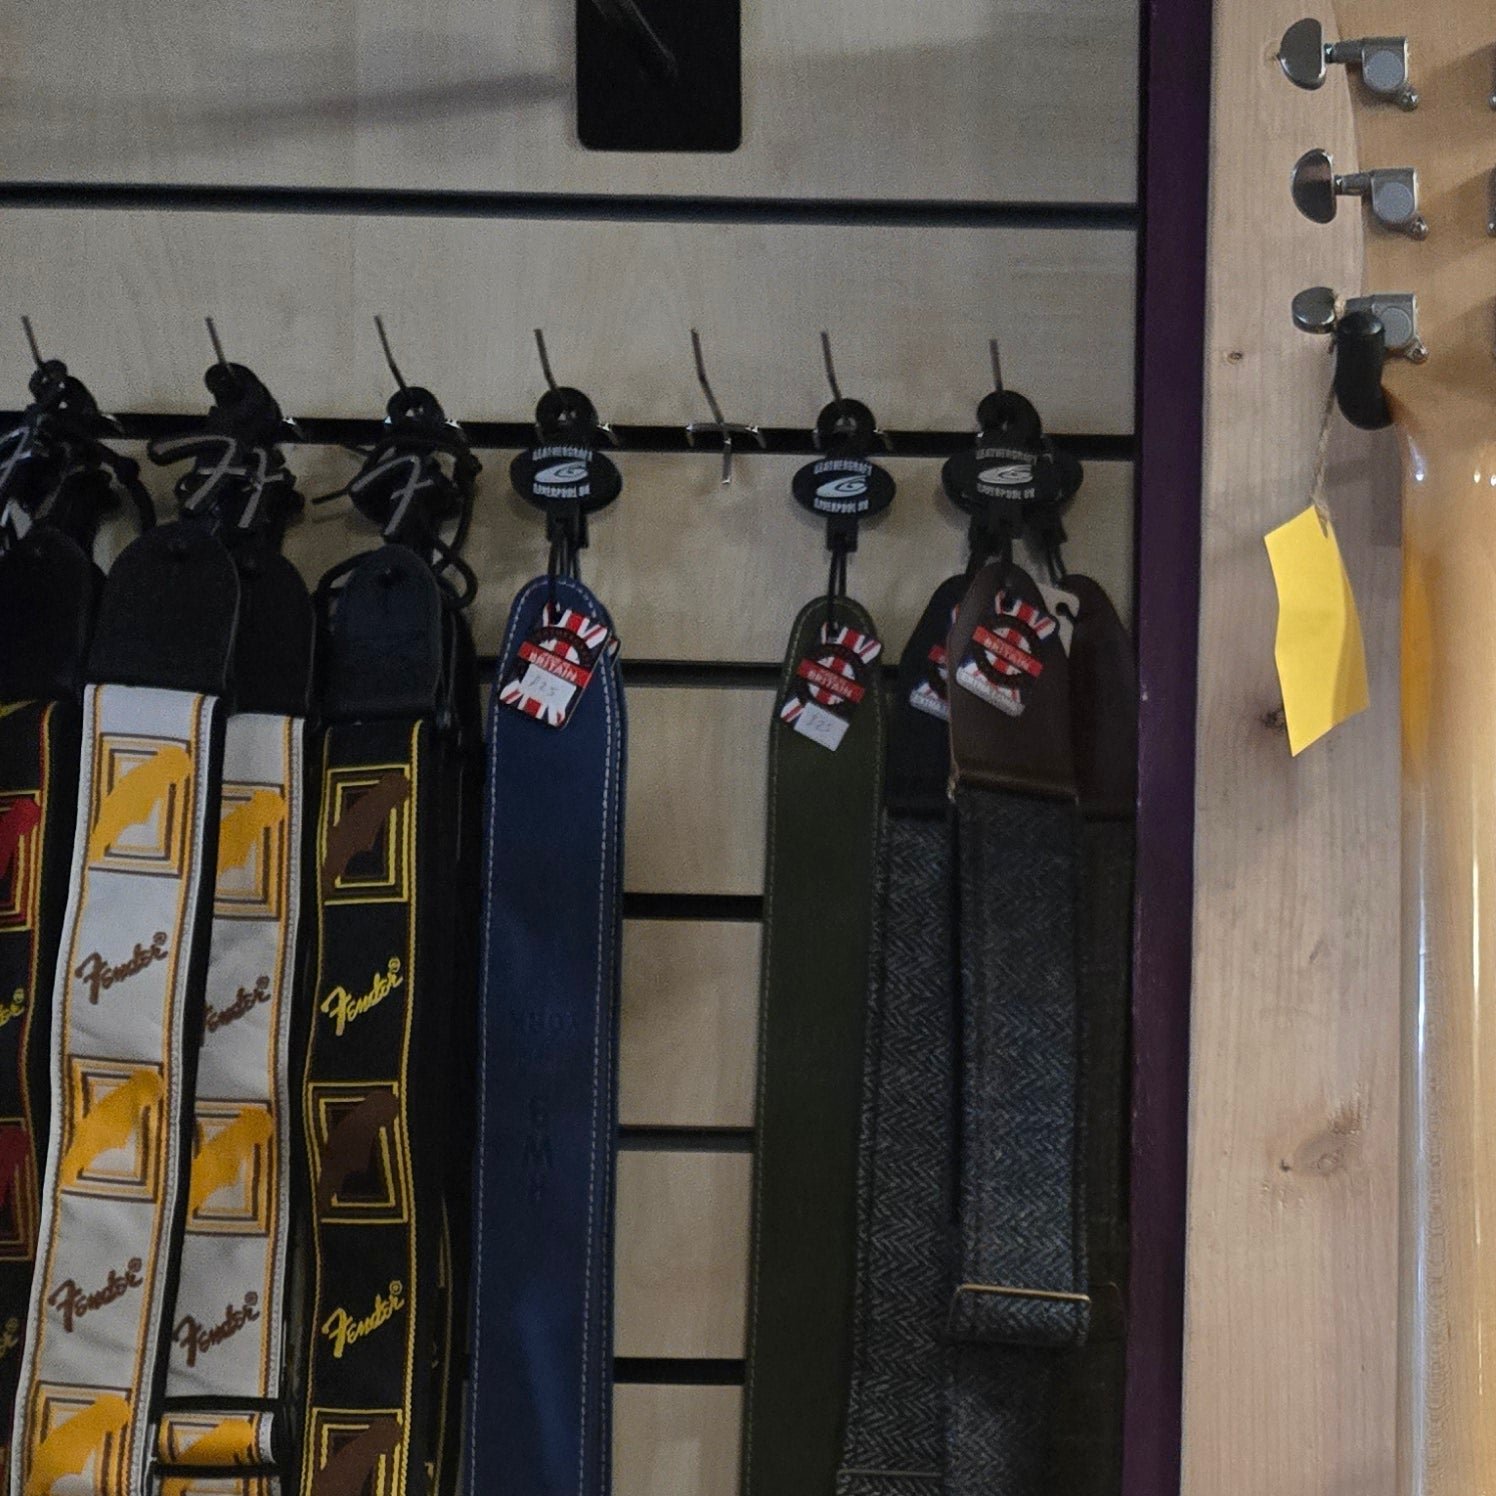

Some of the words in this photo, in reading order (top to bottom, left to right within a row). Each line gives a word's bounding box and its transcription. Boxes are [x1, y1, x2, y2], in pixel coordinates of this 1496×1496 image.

[527, 652, 578, 682] BRITAIN
[75, 940, 168, 1004] Fender
[321, 968, 404, 1036] Fender
[48, 1267, 143, 1332] Fender
[321, 1291, 404, 1358] Fender
[172, 1302, 261, 1367] Fender
